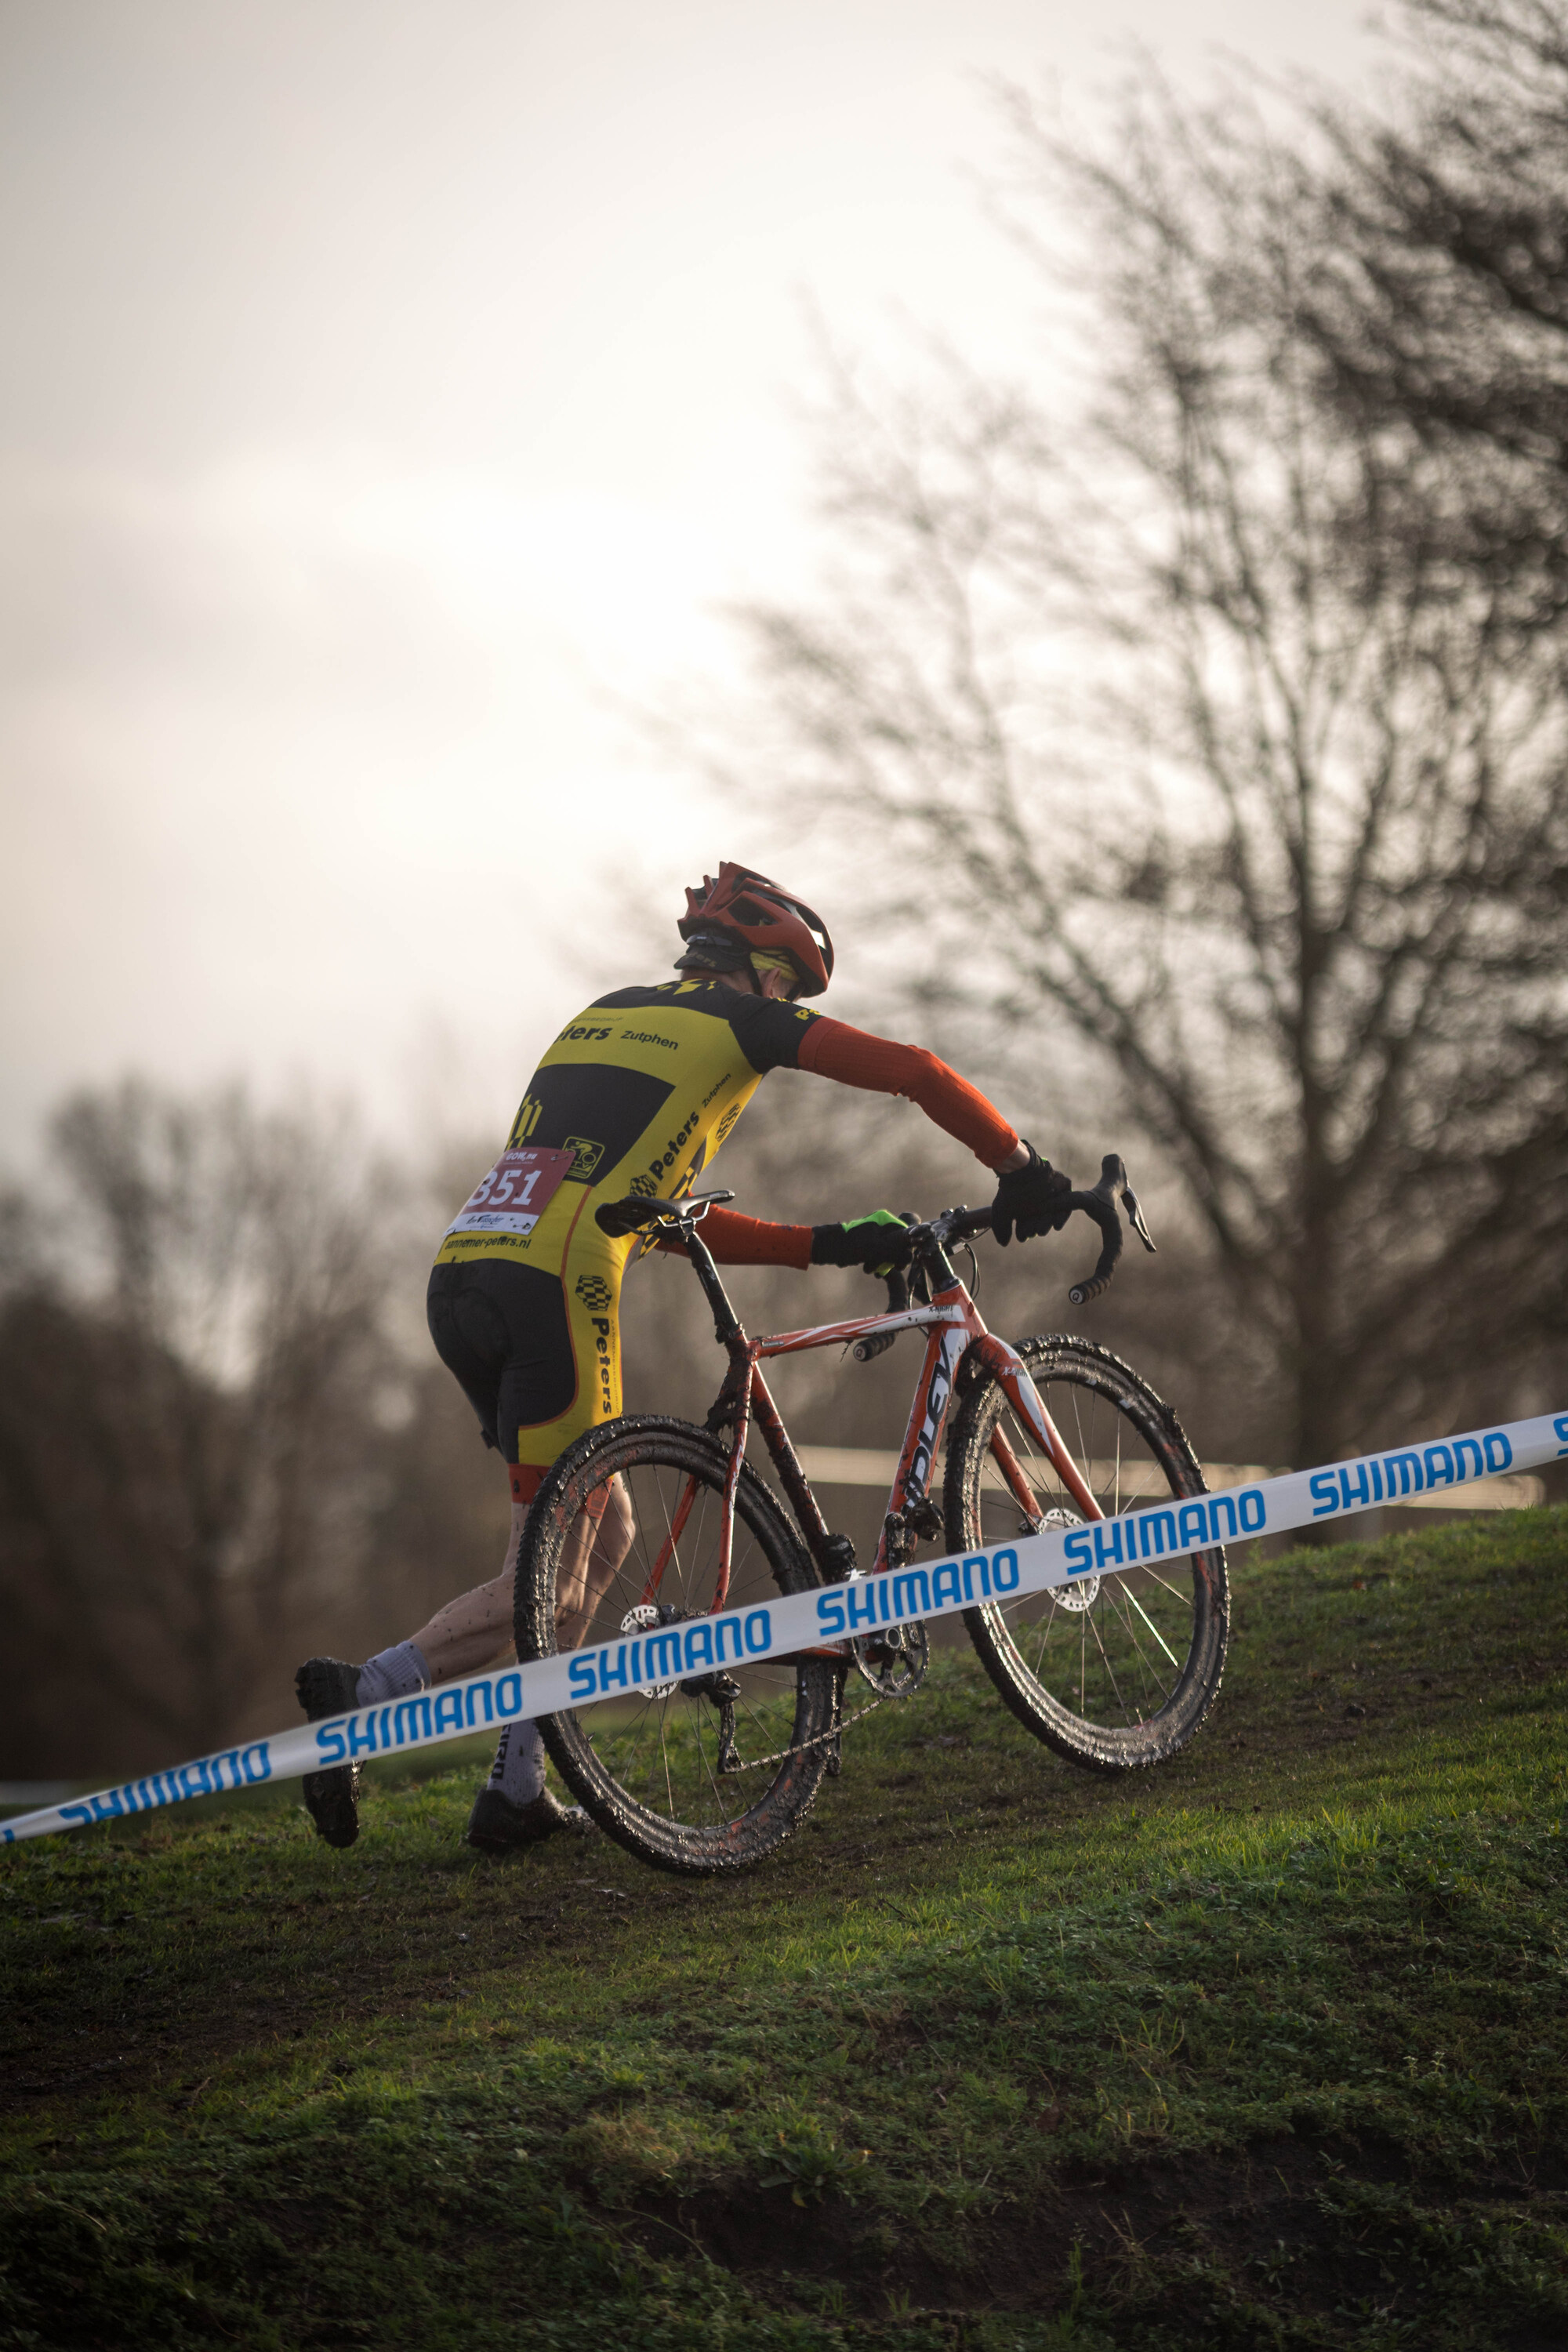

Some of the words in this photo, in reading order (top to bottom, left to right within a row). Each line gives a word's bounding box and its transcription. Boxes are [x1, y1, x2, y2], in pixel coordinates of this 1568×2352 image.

[621, 1030, 679, 1051] Zutphen
[702, 1073, 731, 1109] Zutphen
[649, 1111, 699, 1181] Peters
[467, 1170, 543, 1207] 351
[591, 1318, 612, 1414] Peters
[316, 1673, 521, 1765] SHIMANO
[568, 1610, 771, 1700] SHIMANO
[817, 1548, 1019, 1636] SHIMANO
[1064, 1489, 1267, 1576] SHIMANO
[1310, 1432, 1513, 1516] SHIMANO
